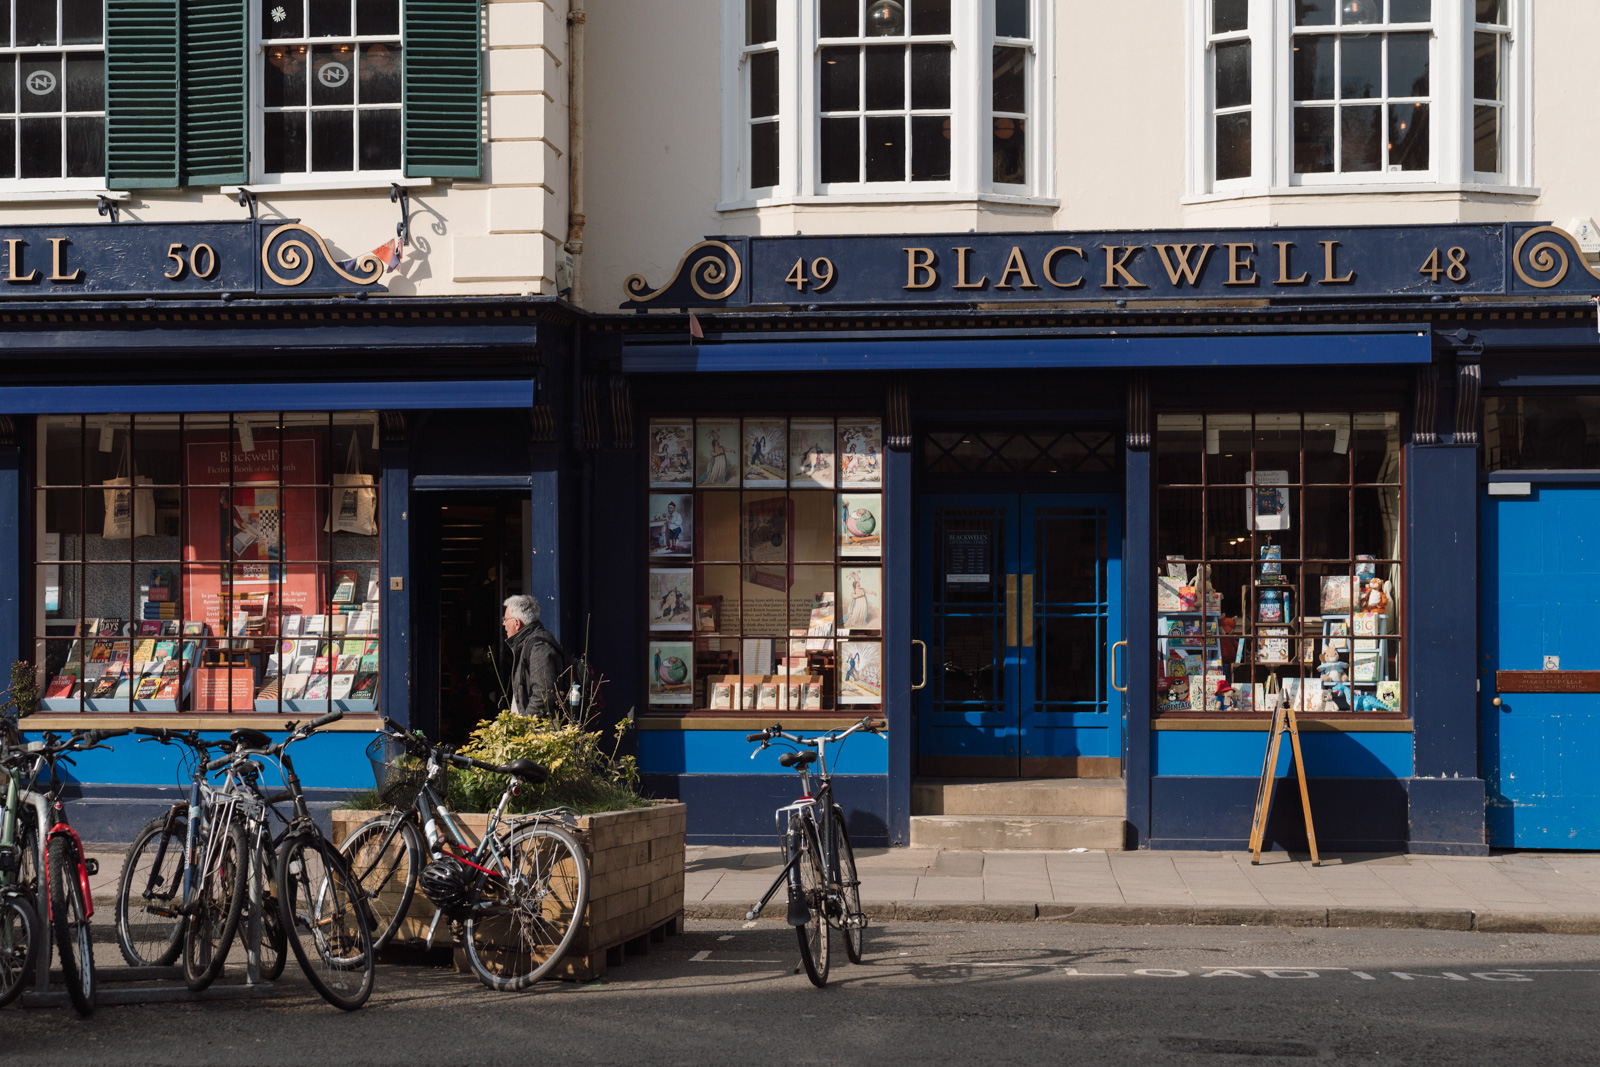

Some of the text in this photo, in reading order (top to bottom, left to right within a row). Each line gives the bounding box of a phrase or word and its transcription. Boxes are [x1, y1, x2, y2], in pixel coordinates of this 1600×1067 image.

[164, 242, 215, 279] 50
[785, 240, 1468, 292] 49 BLACKWELL 48
[234, 464, 254, 473] Book
[271, 463, 296, 472] Mnth
[100, 622, 119, 631] DAYS
[1354, 620, 1374, 631] BIG
